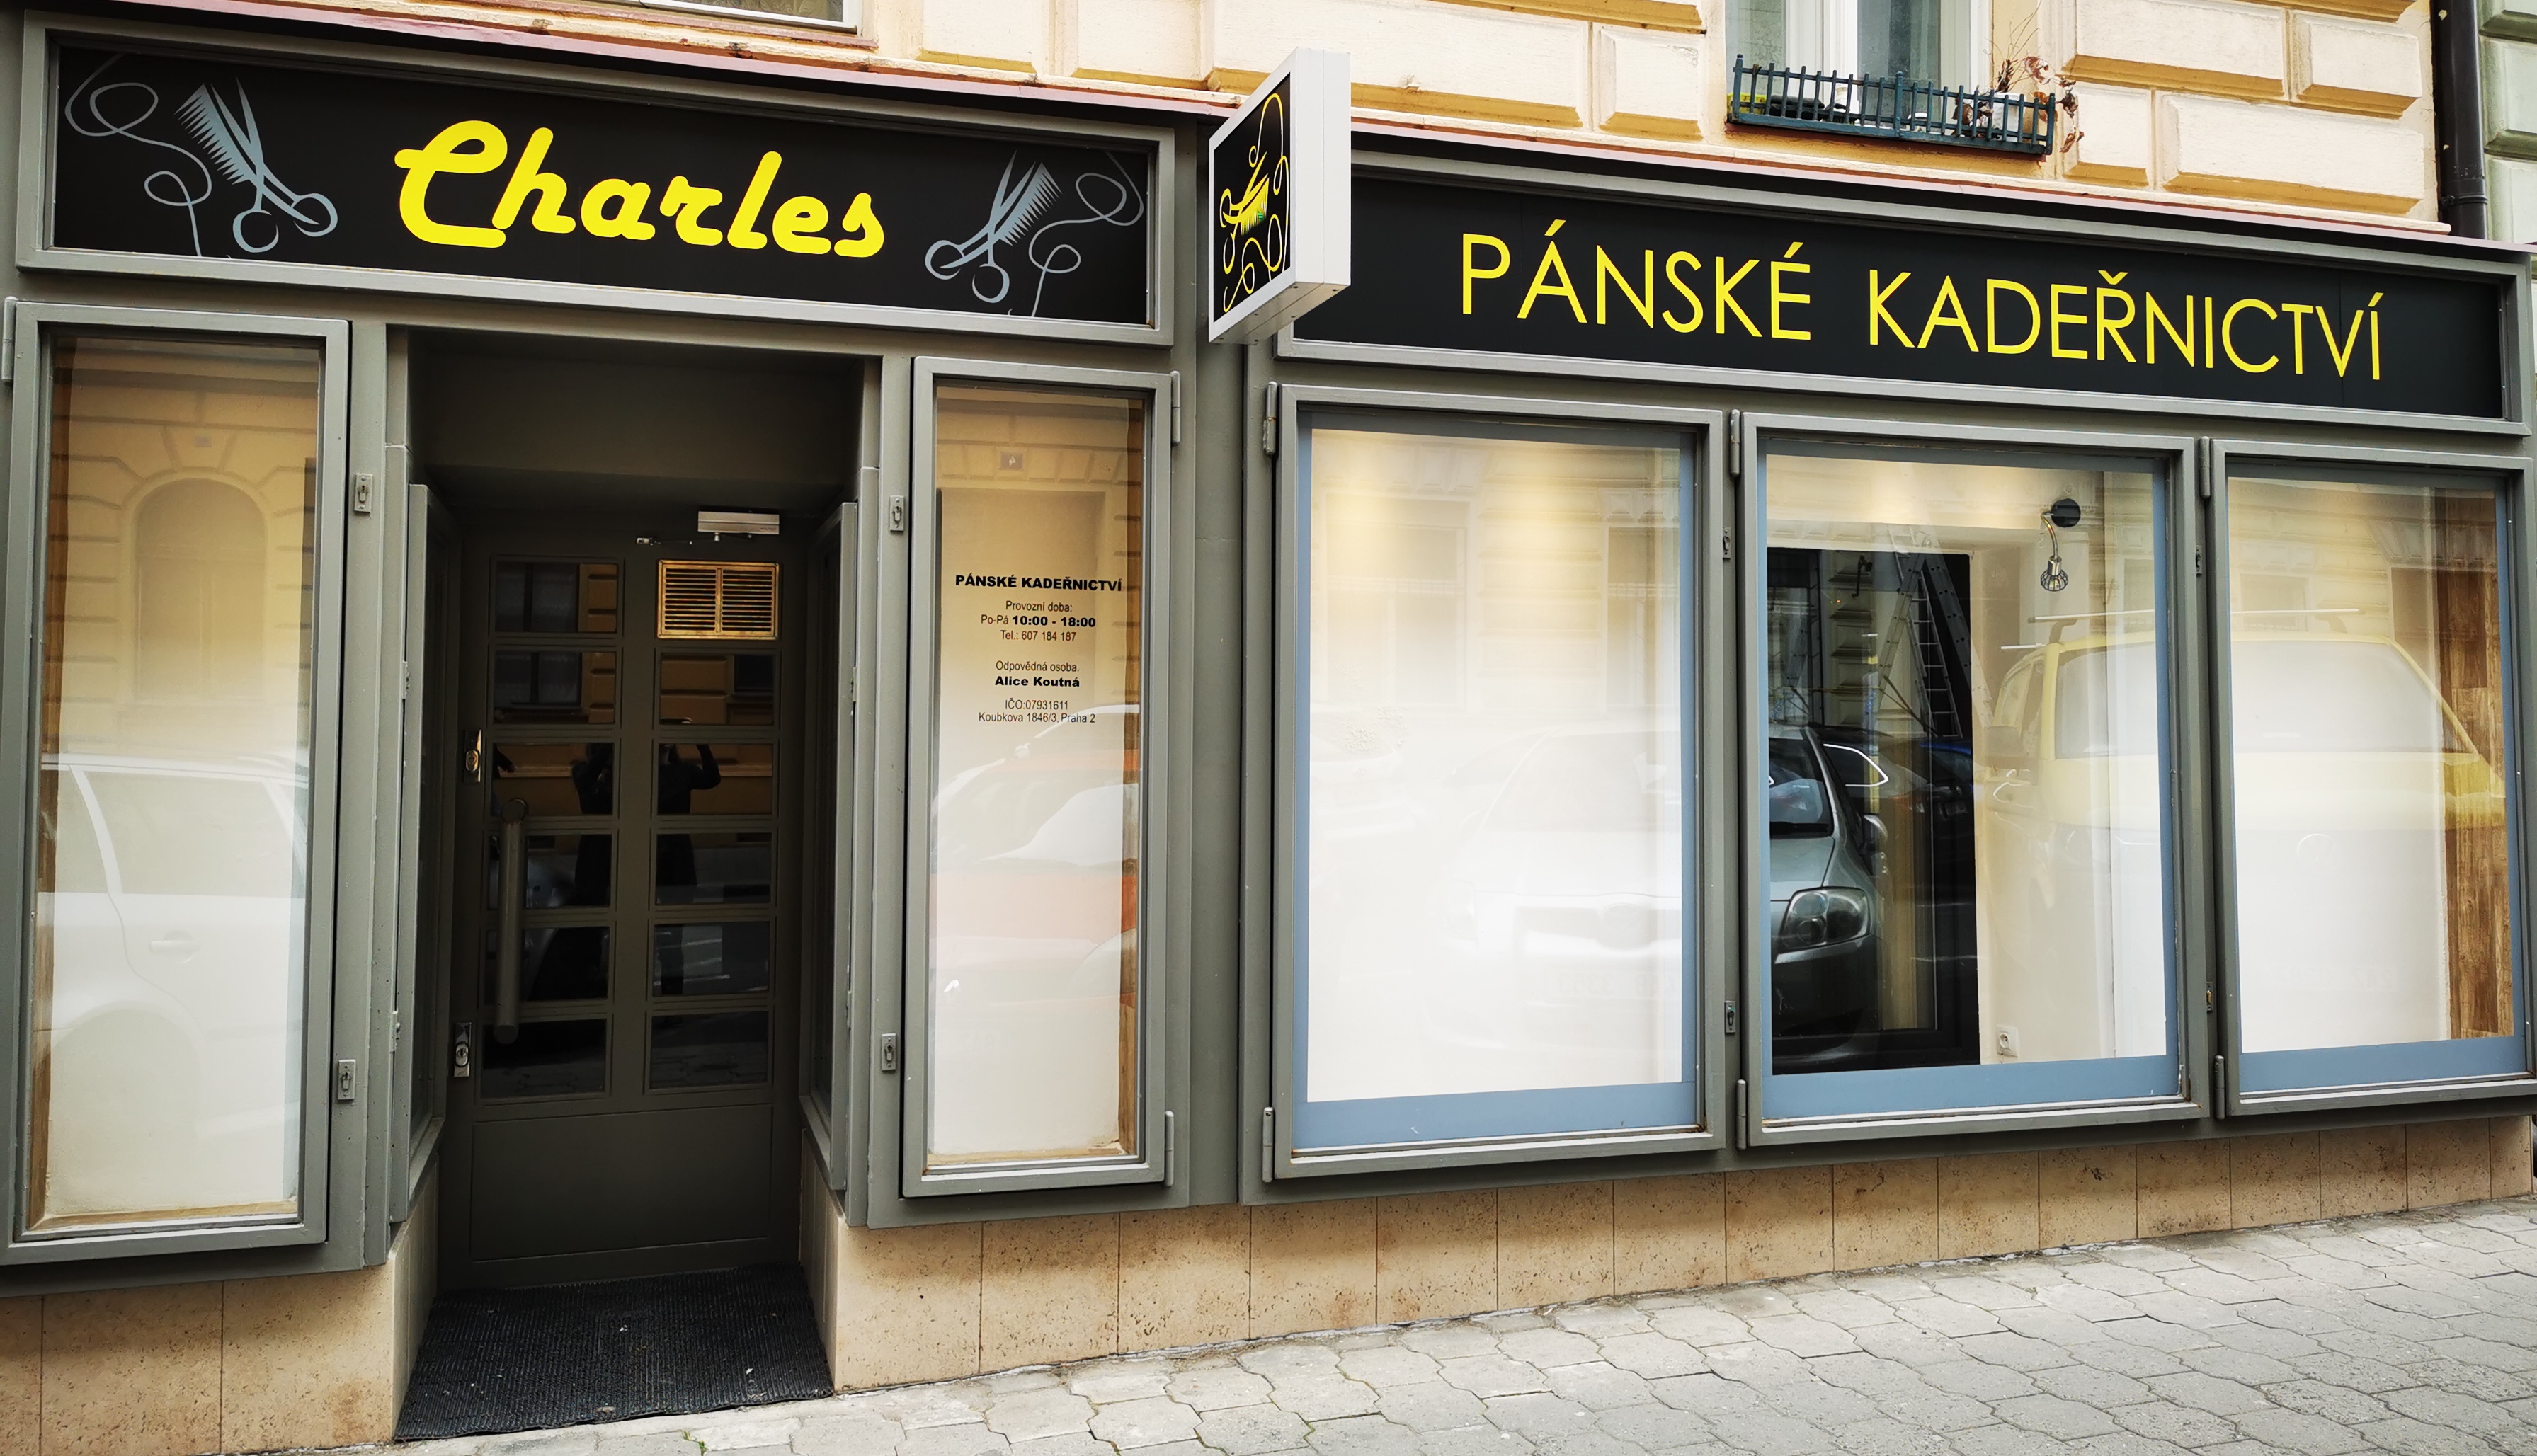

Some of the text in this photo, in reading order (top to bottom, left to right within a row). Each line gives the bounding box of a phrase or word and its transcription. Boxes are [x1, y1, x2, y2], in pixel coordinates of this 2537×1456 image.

[394, 120, 885, 258] Charles
[1461, 219, 2384, 380] PÁNSKÉ KADEŘNICTVÍ
[955, 573, 1122, 591] PÁNSKÉ KADEŘNICTVÍ
[1005, 600, 1073, 613] Provozní doba:
[981, 614, 1010, 625] Po-Pá
[1012, 615, 1049, 626] 10:00
[1060, 617, 1097, 628] 18:00
[1000, 630, 1077, 642] Tel.: 607 184 187
[996, 660, 1048, 673] Odpovědná
[995, 675, 1081, 687] Alice Koutná
[1005, 697, 1069, 710] IČO:07931611
[979, 712, 1024, 722] Koubkova
[1061, 713, 1088, 723] Praha
[1090, 713, 1096, 723] 2
